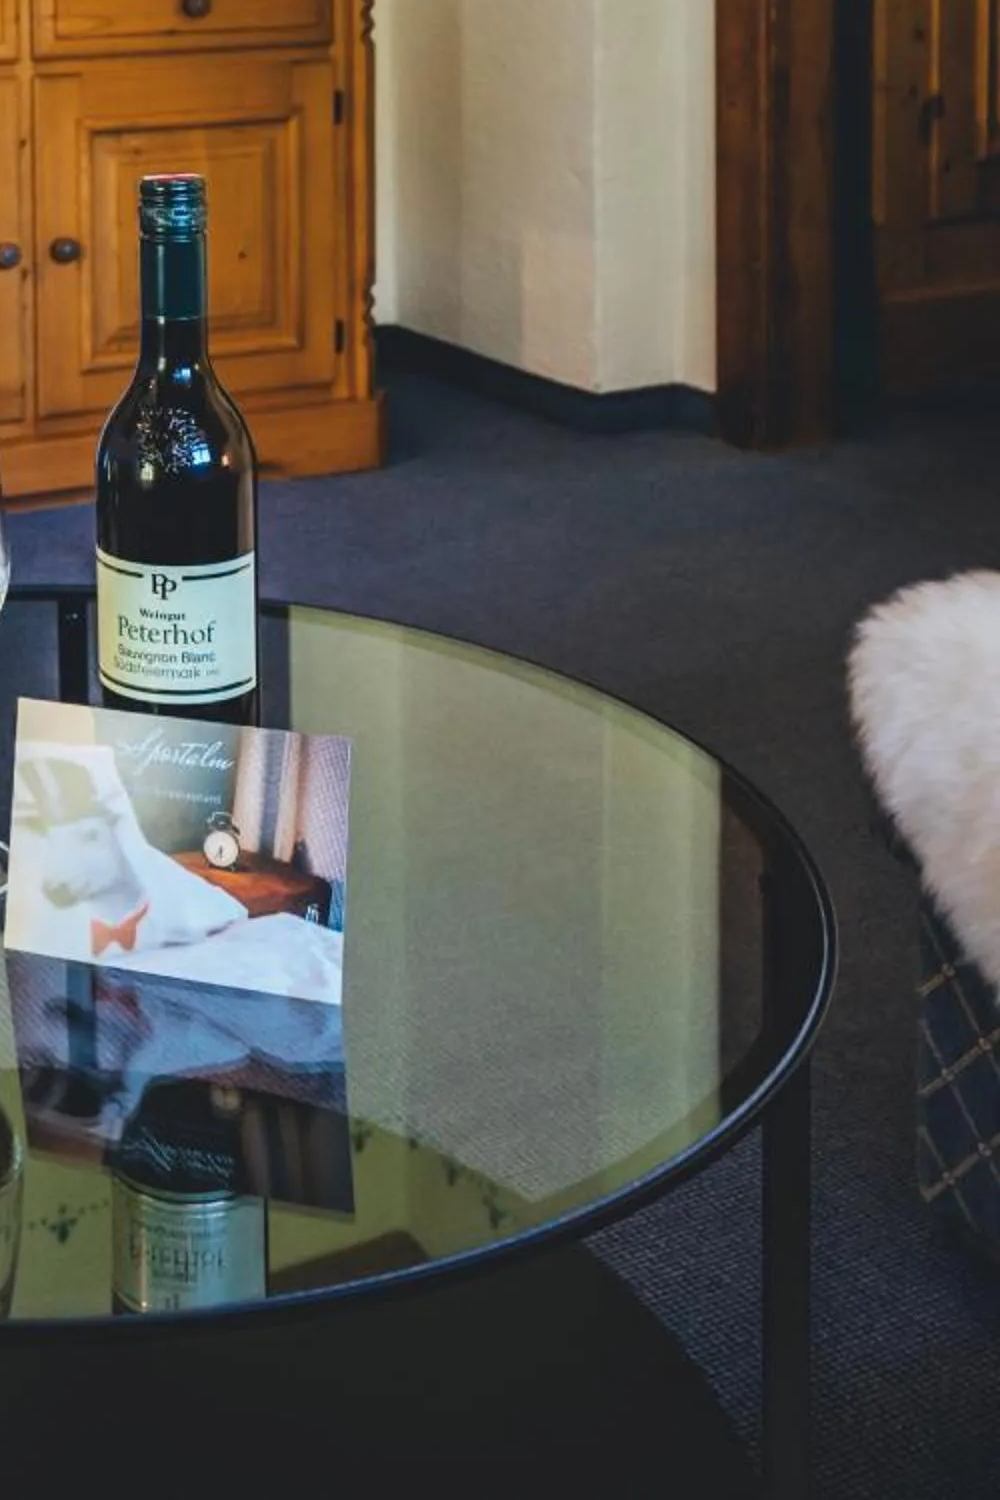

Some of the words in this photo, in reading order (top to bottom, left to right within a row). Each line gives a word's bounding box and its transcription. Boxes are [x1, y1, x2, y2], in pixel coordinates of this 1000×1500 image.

[139, 608, 186, 622] Weingut
[117, 614, 218, 645] Peterhof
[117, 644, 177, 665] Sauvignon
[181, 651, 217, 664] Blanc
